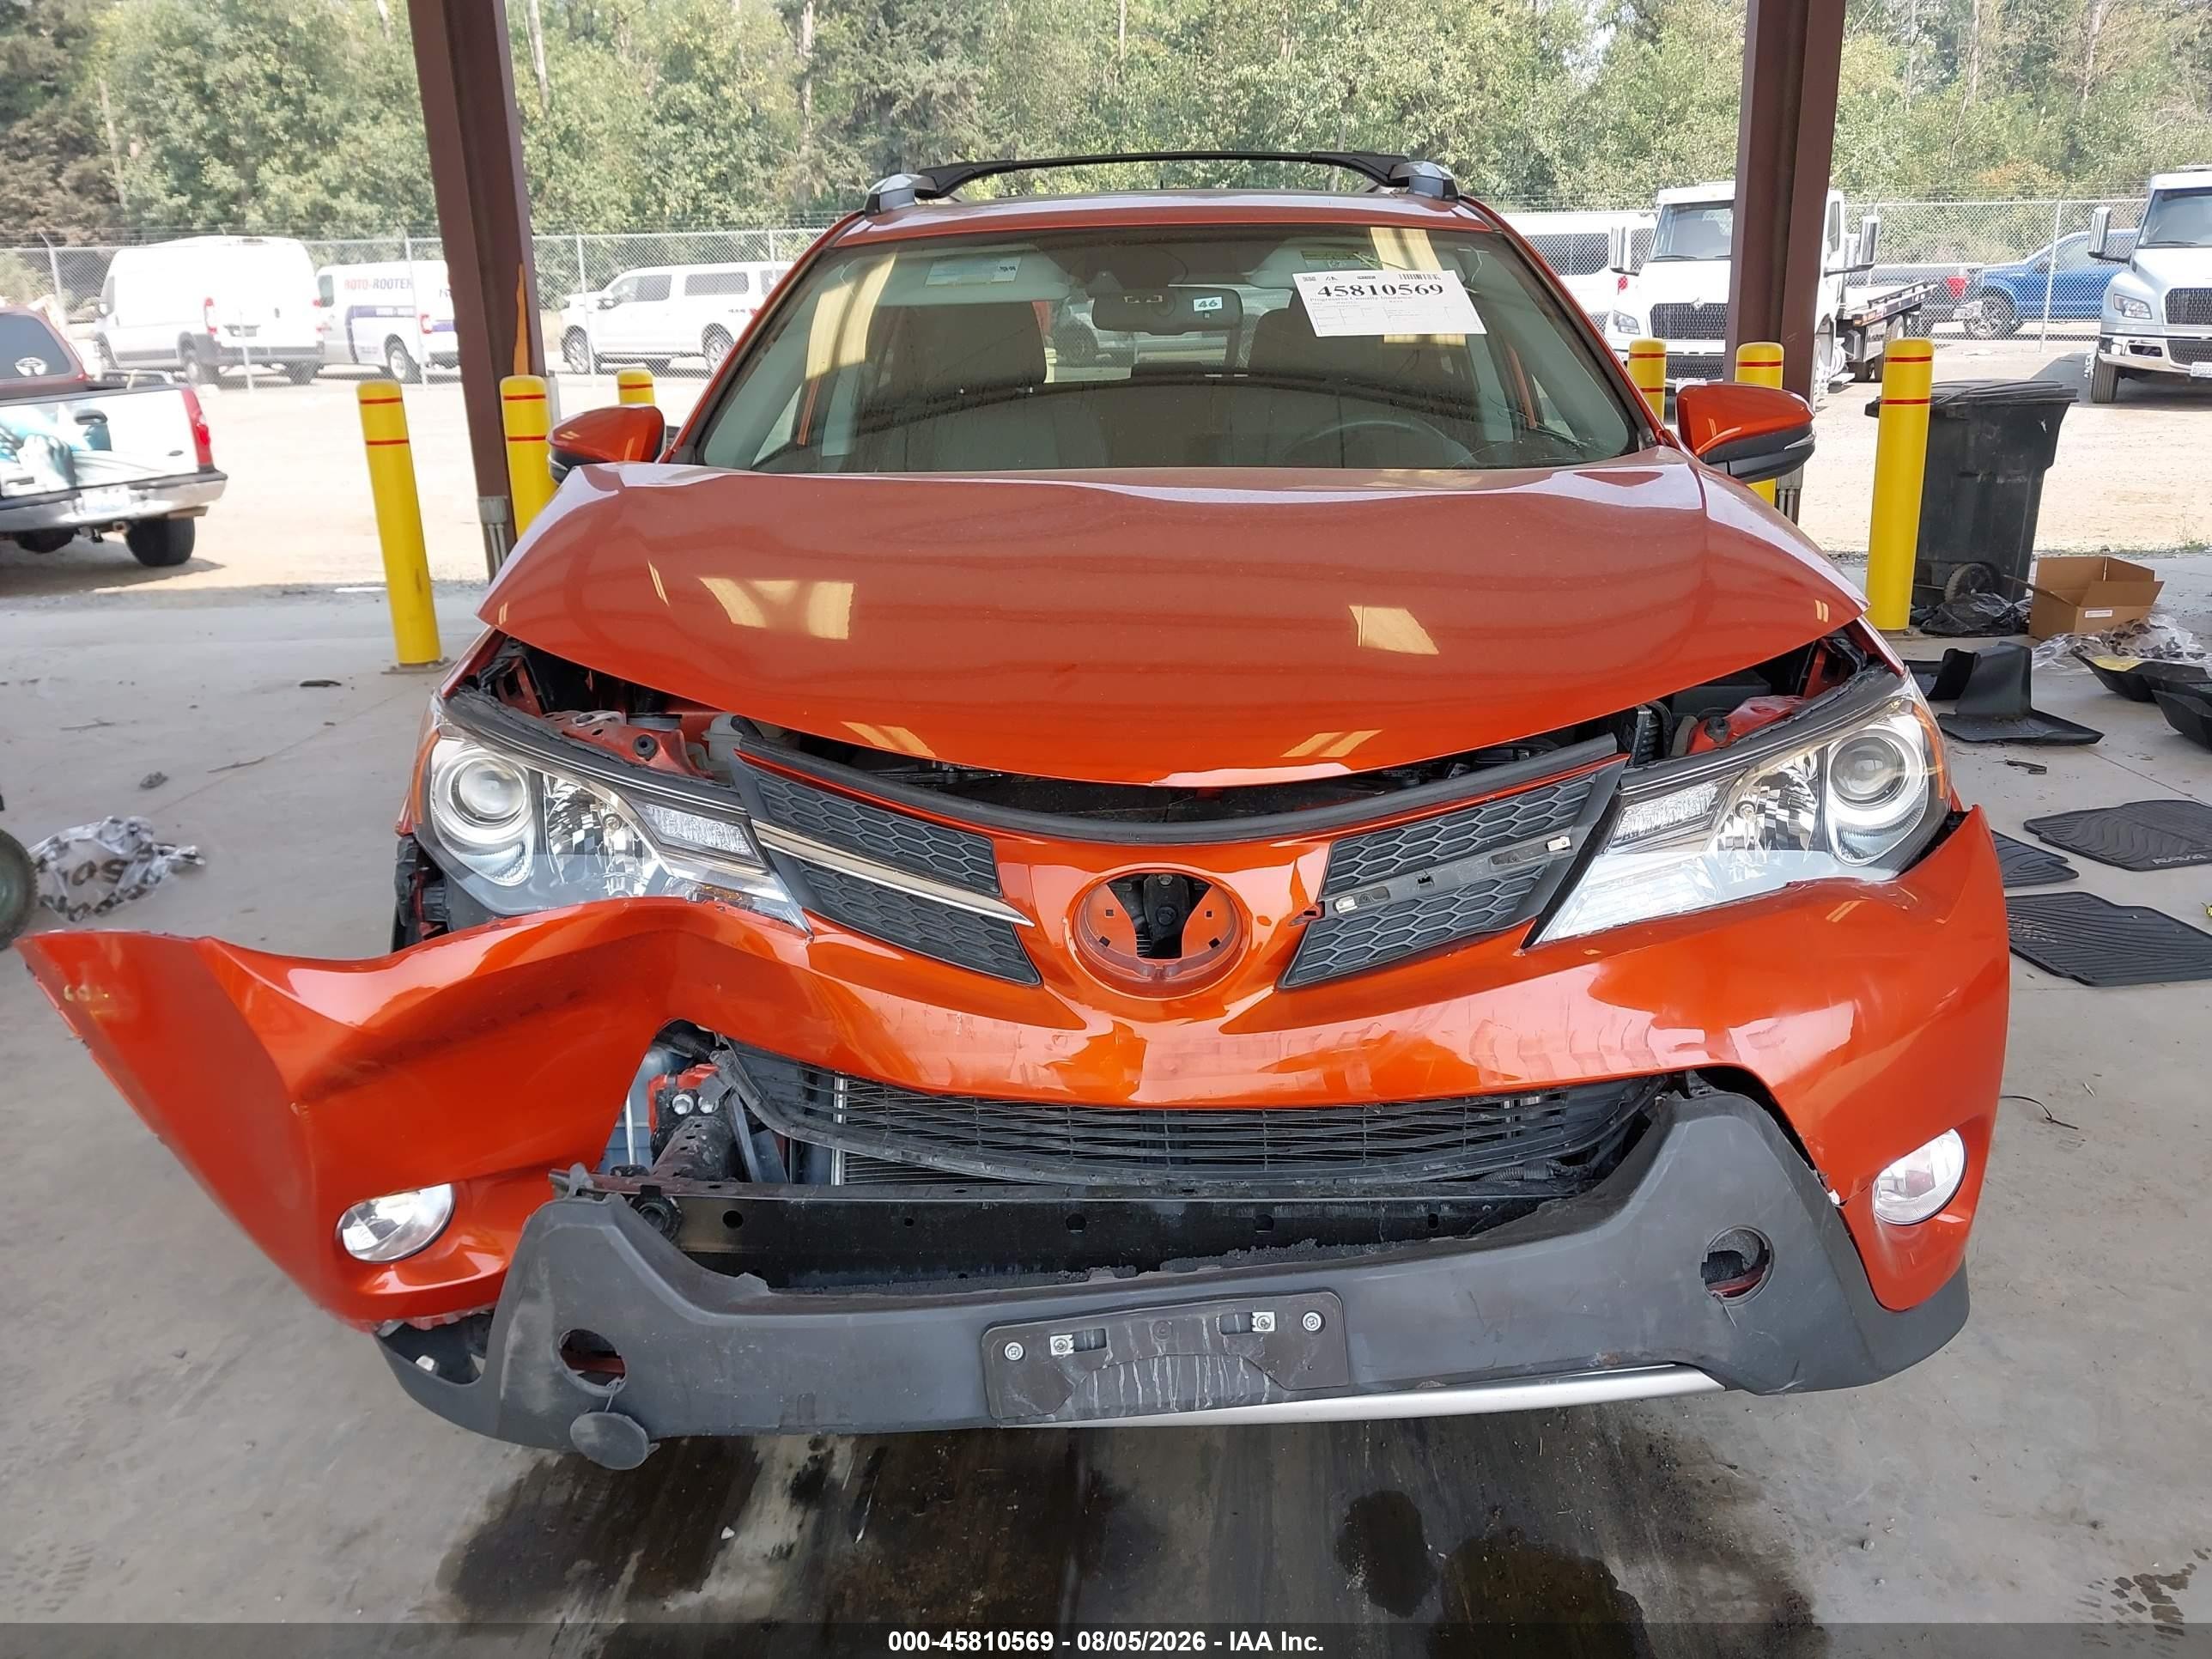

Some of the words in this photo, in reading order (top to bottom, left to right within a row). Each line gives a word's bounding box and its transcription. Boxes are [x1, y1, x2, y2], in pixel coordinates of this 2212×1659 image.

[1317, 283, 1443, 297] 45810569
[1197, 299, 1218, 308] 46
[2151, 854, 2208, 865] RAV4
